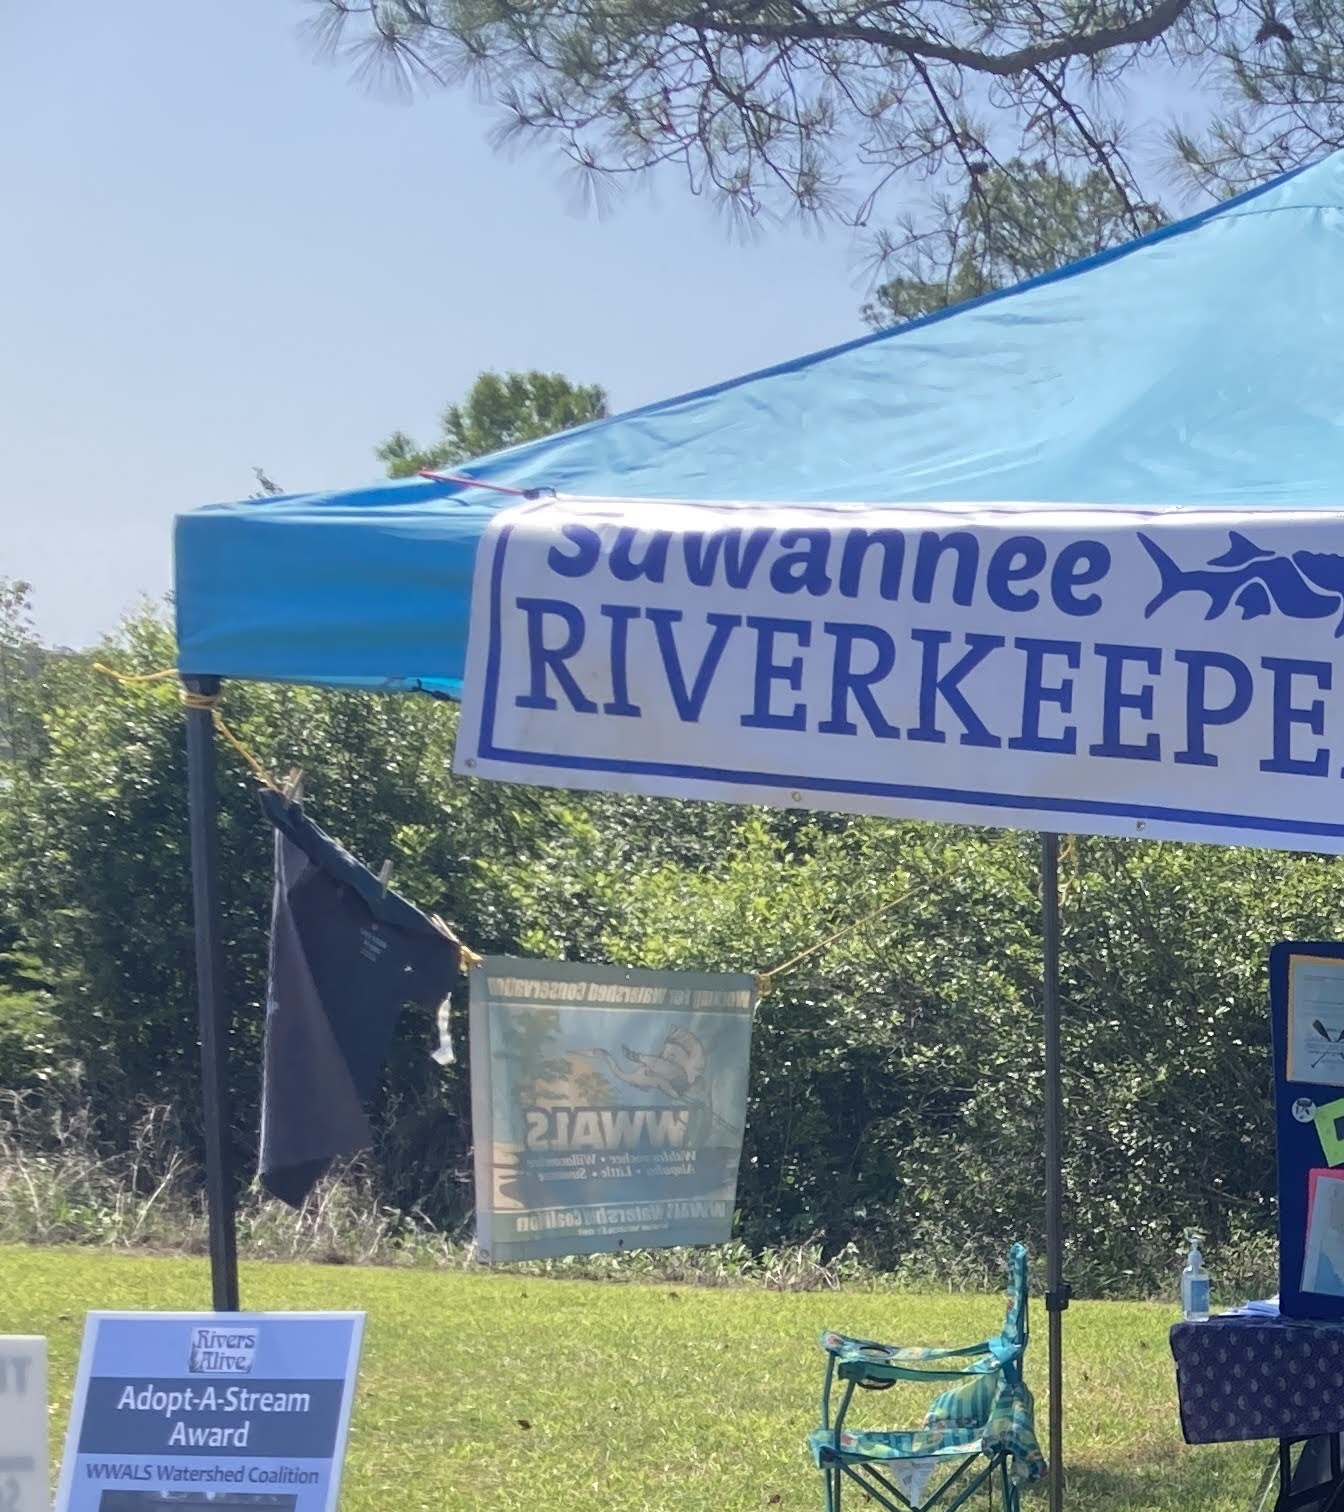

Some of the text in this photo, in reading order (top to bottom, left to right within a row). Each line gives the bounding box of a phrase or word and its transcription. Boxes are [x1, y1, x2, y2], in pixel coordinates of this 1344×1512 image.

[196, 1330, 256, 1349] Rivers
[117, 1384, 311, 1417] Adopt-A-Stream
[168, 1420, 250, 1447] Award
[86, 1463, 319, 1484] WWALS Watershed Coalition
